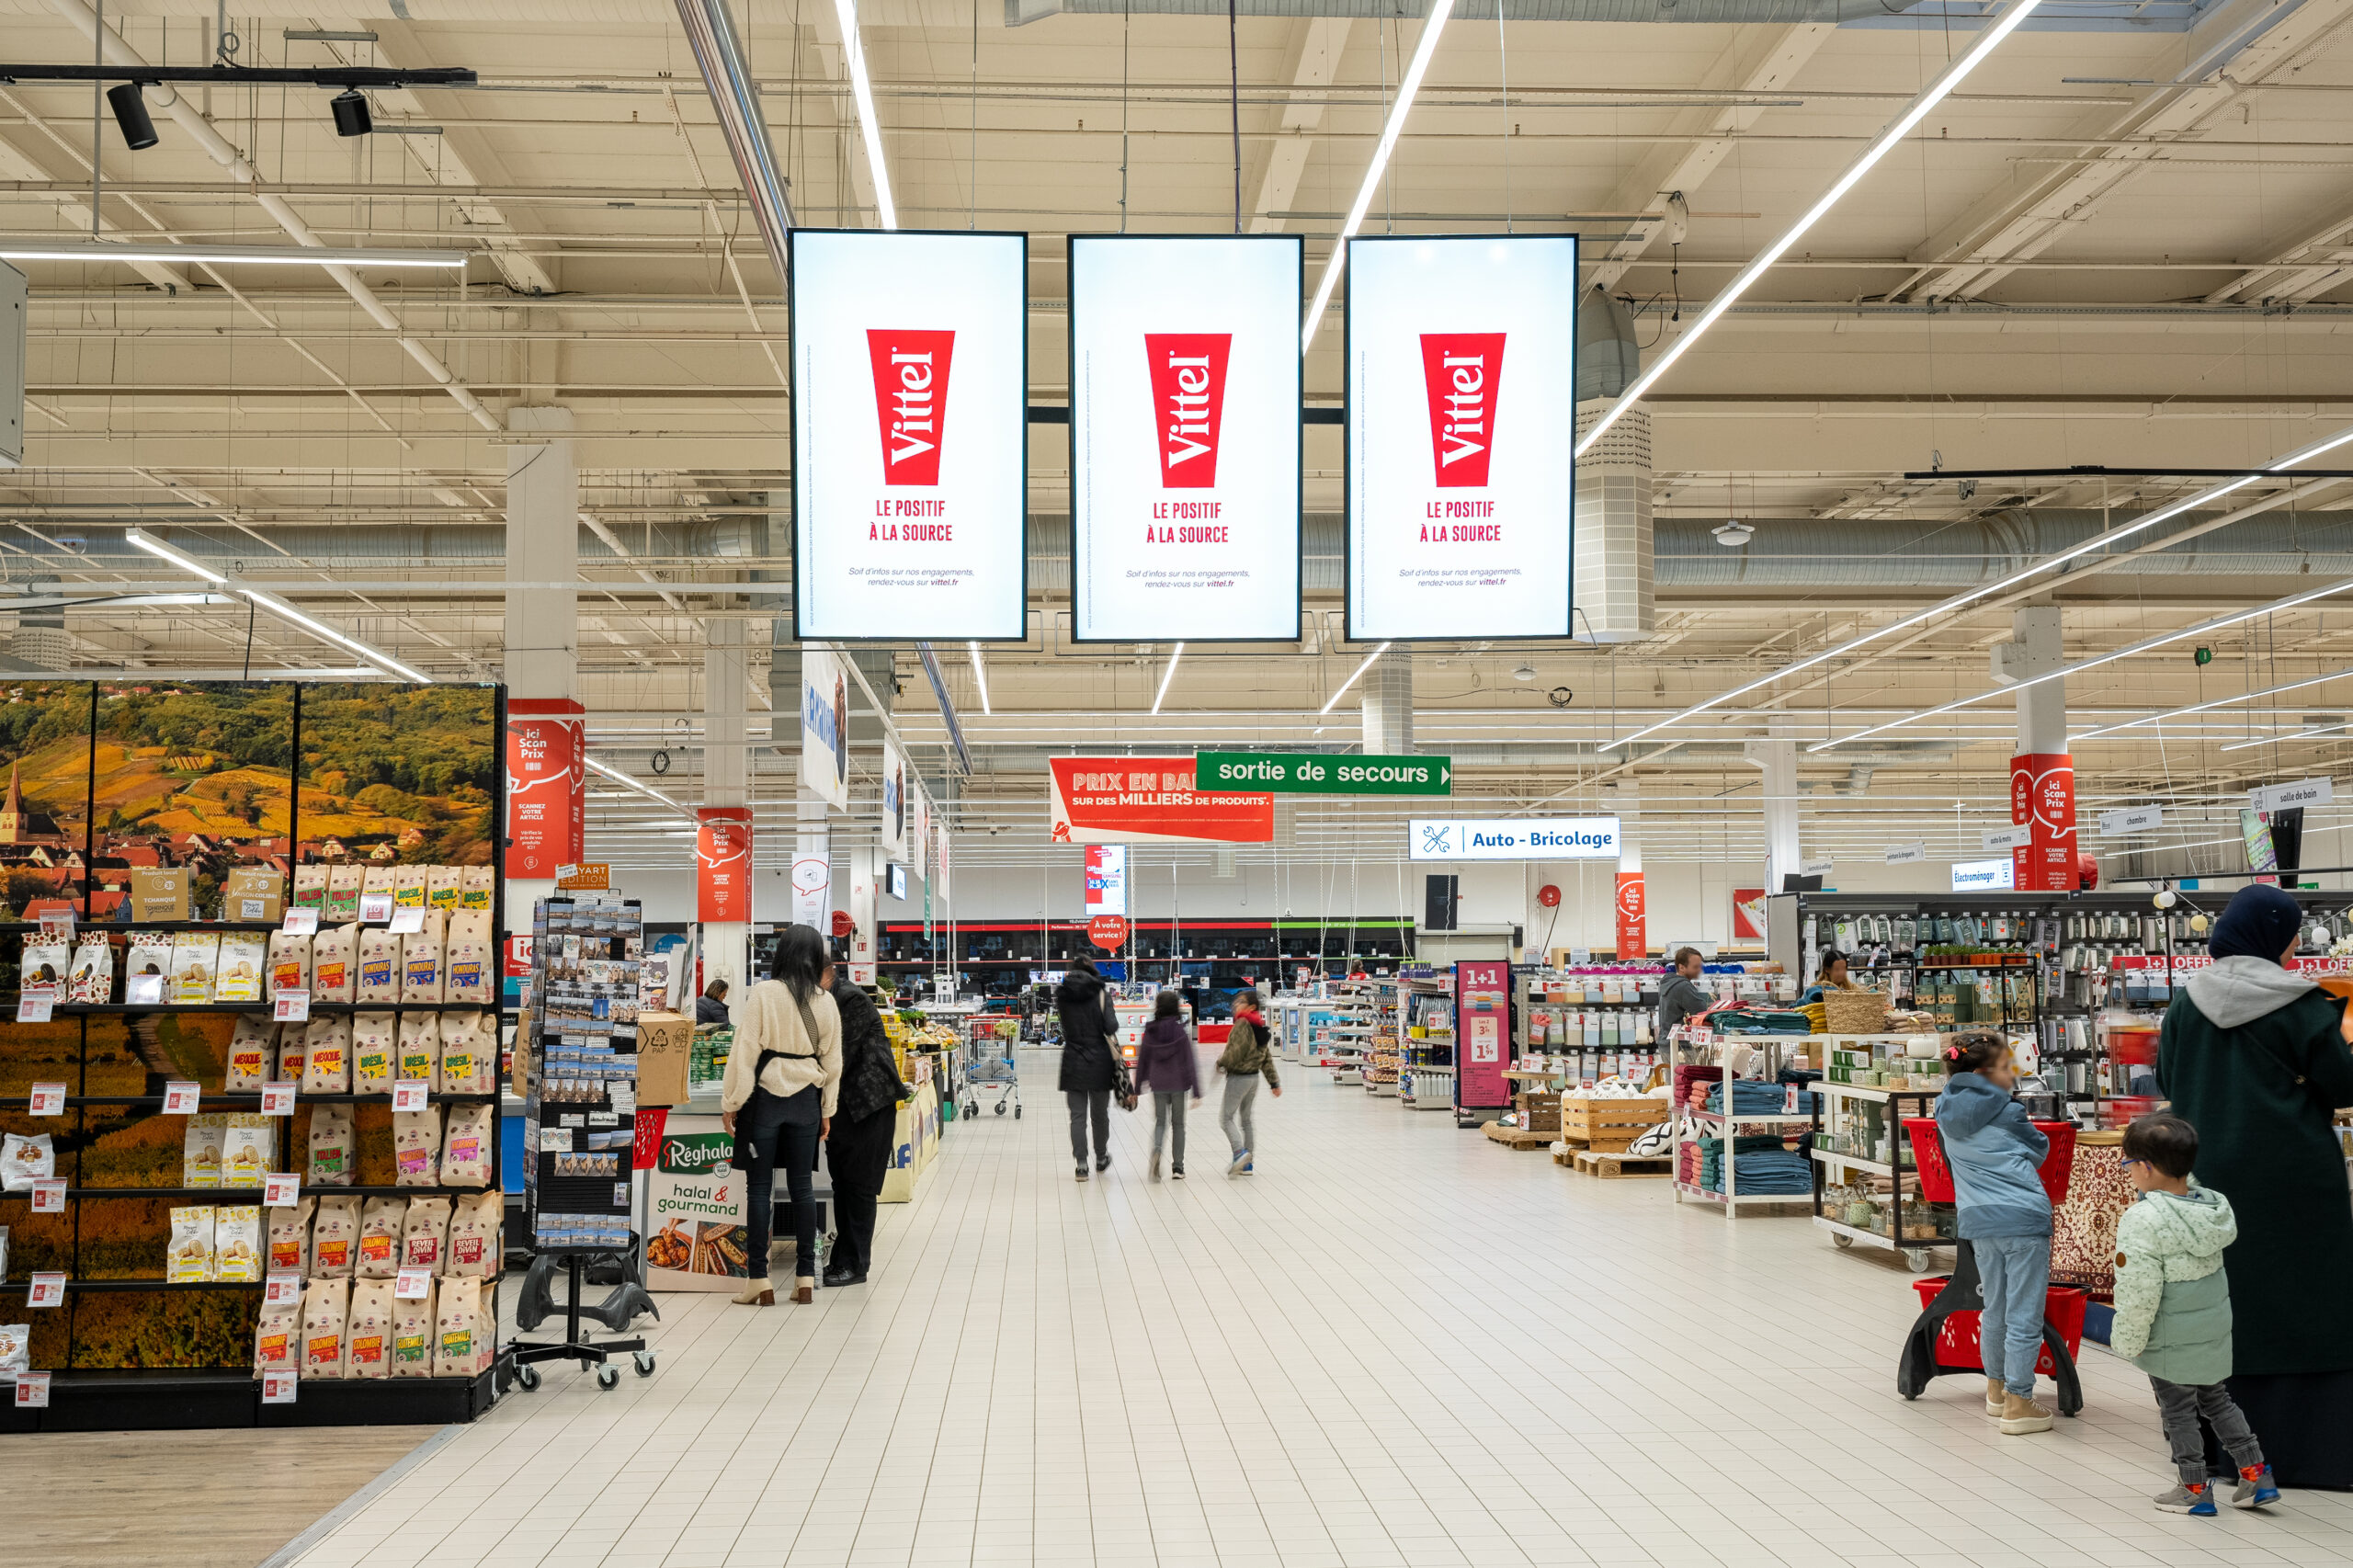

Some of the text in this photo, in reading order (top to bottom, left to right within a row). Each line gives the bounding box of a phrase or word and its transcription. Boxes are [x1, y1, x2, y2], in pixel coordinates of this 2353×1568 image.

[891, 351, 935, 466] Vittel
[1168, 354, 1211, 469] Vittel
[1442, 354, 1485, 469] Vittel
[876, 500, 945, 517] LE POSITIF
[1154, 503, 1222, 519] LE POSITIF
[1427, 501, 1495, 518] LE POSITIF
[870, 522, 952, 541] À LA SOURCE
[1146, 524, 1229, 542] À LA SOURCE
[1420, 524, 1501, 542] À LA SOURCE
[848, 567, 863, 575] Soif
[865, 567, 890, 576] d'infos
[921, 569, 974, 578] engagements,
[1126, 570, 1140, 578] Soif
[1142, 570, 1166, 578] d'infos
[1198, 570, 1250, 580] engagements,
[1399, 568, 1414, 577] Soif
[1415, 568, 1439, 577] d'infos
[1471, 568, 1522, 577] engagements,
[868, 578, 914, 586] rendez-vous
[930, 578, 959, 586] vittel.fr
[1144, 580, 1190, 588] rendez-vous
[1207, 580, 1235, 588] vittel.fr
[1479, 577, 1506, 586] vittel.fr
[526, 729, 540, 739] ici
[518, 739, 547, 748] Scan
[520, 748, 544, 758] Prix
[1219, 760, 1428, 783] sortie de secours
[1073, 773, 1123, 791] PRIX
[1129, 773, 1157, 791] EN
[2049, 781, 2060, 790] ici
[1073, 797, 1094, 805] SUR
[1096, 797, 1117, 805] DES
[1119, 793, 1193, 806] MILLIERS
[1195, 797, 1210, 805] DE
[2043, 790, 2066, 798] Scan
[2279, 789, 2317, 803] salle de bain
[2046, 799, 2064, 808] Prix
[2126, 815, 2147, 825] chambre
[1472, 832, 1515, 846] Auto
[1530, 831, 1612, 848] Bricolage
[561, 875, 607, 883] EDITION
[1954, 870, 1995, 882] Électroménager
[298, 889, 323, 902] ITALIEN
[332, 889, 356, 901] ITALIEN
[1095, 920, 1101, 928] À
[319, 963, 344, 975] COLOMBIE
[364, 960, 390, 973] HONDURAS
[408, 961, 435, 973] HONDURAS
[452, 963, 479, 974] HONDURAS
[2145, 957, 2217, 969] 1+1 OFFE
[2298, 959, 2322, 971] 1+1
[1467, 970, 1497, 984] 1+1
[316, 1148, 341, 1161] ITALIEN
[671, 1140, 733, 1167] Réghala
[674, 1184, 728, 1202] halal &
[658, 1199, 739, 1216] gourmand
[272, 1243, 298, 1254] COLOMBIE
[319, 1241, 347, 1253] COLOMBIE
[363, 1237, 389, 1248] COLOMBIE
[260, 1337, 286, 1348] COLOMBIE
[309, 1337, 336, 1350] COLOMBIE
[353, 1338, 381, 1350] COLOMBIE
